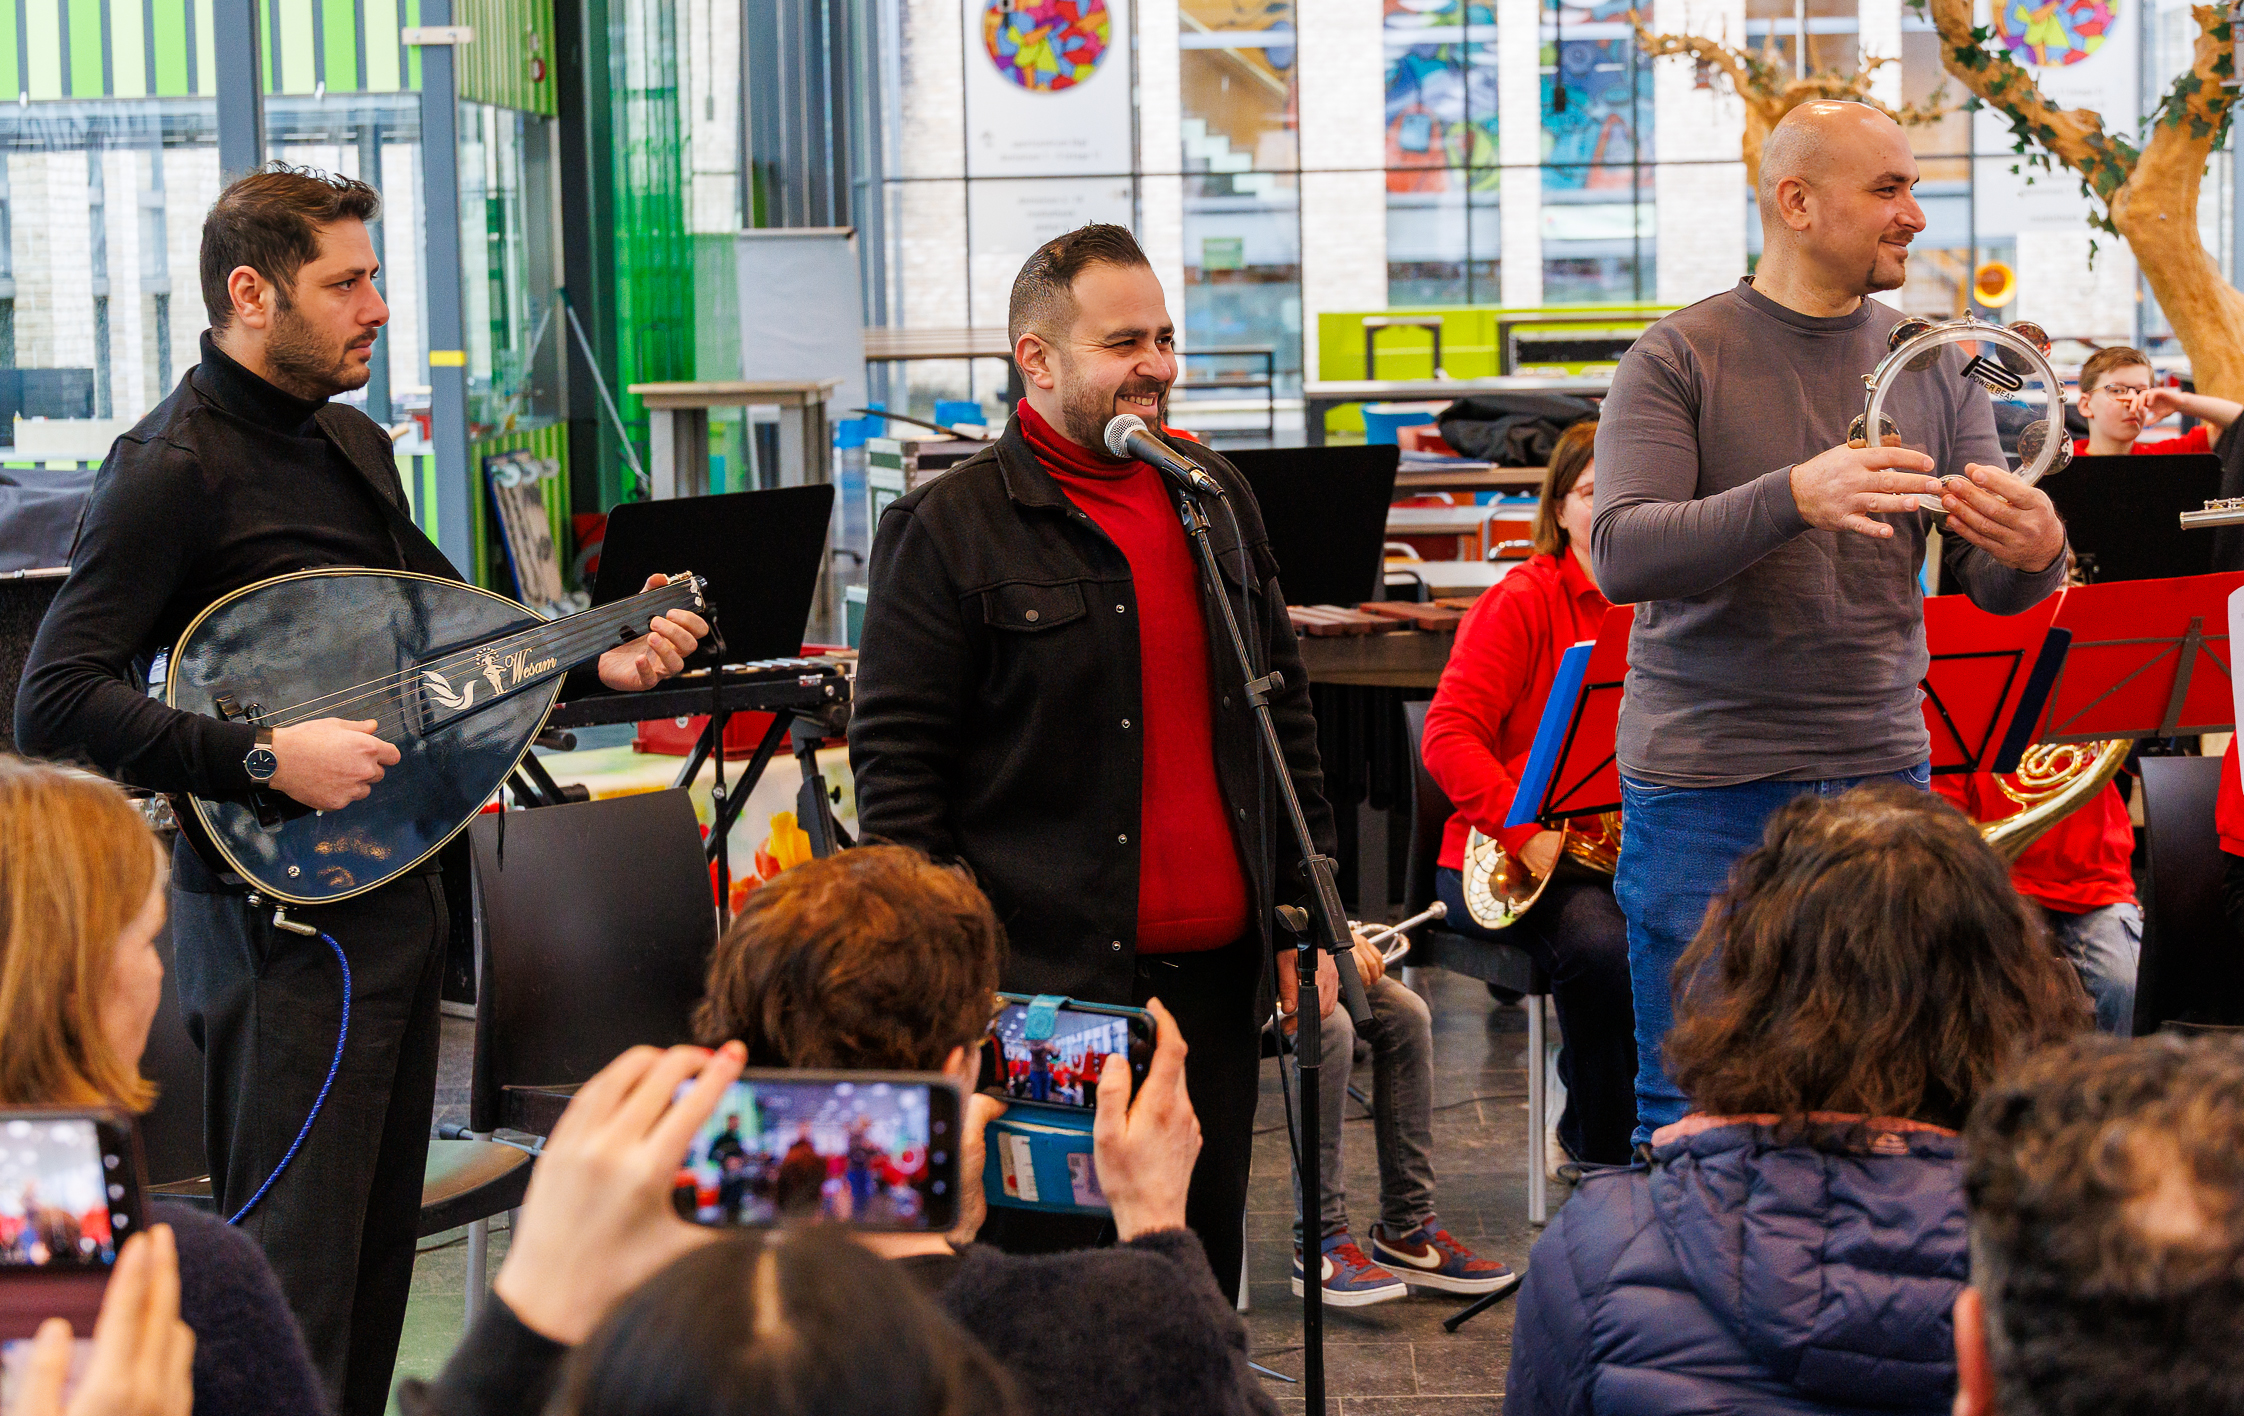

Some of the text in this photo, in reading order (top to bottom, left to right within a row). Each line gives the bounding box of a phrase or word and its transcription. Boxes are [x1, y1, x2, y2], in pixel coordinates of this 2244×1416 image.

[1968, 373, 1996, 391] POWER
[1995, 387, 2016, 401] BEAT
[504, 647, 558, 685] Wesam
